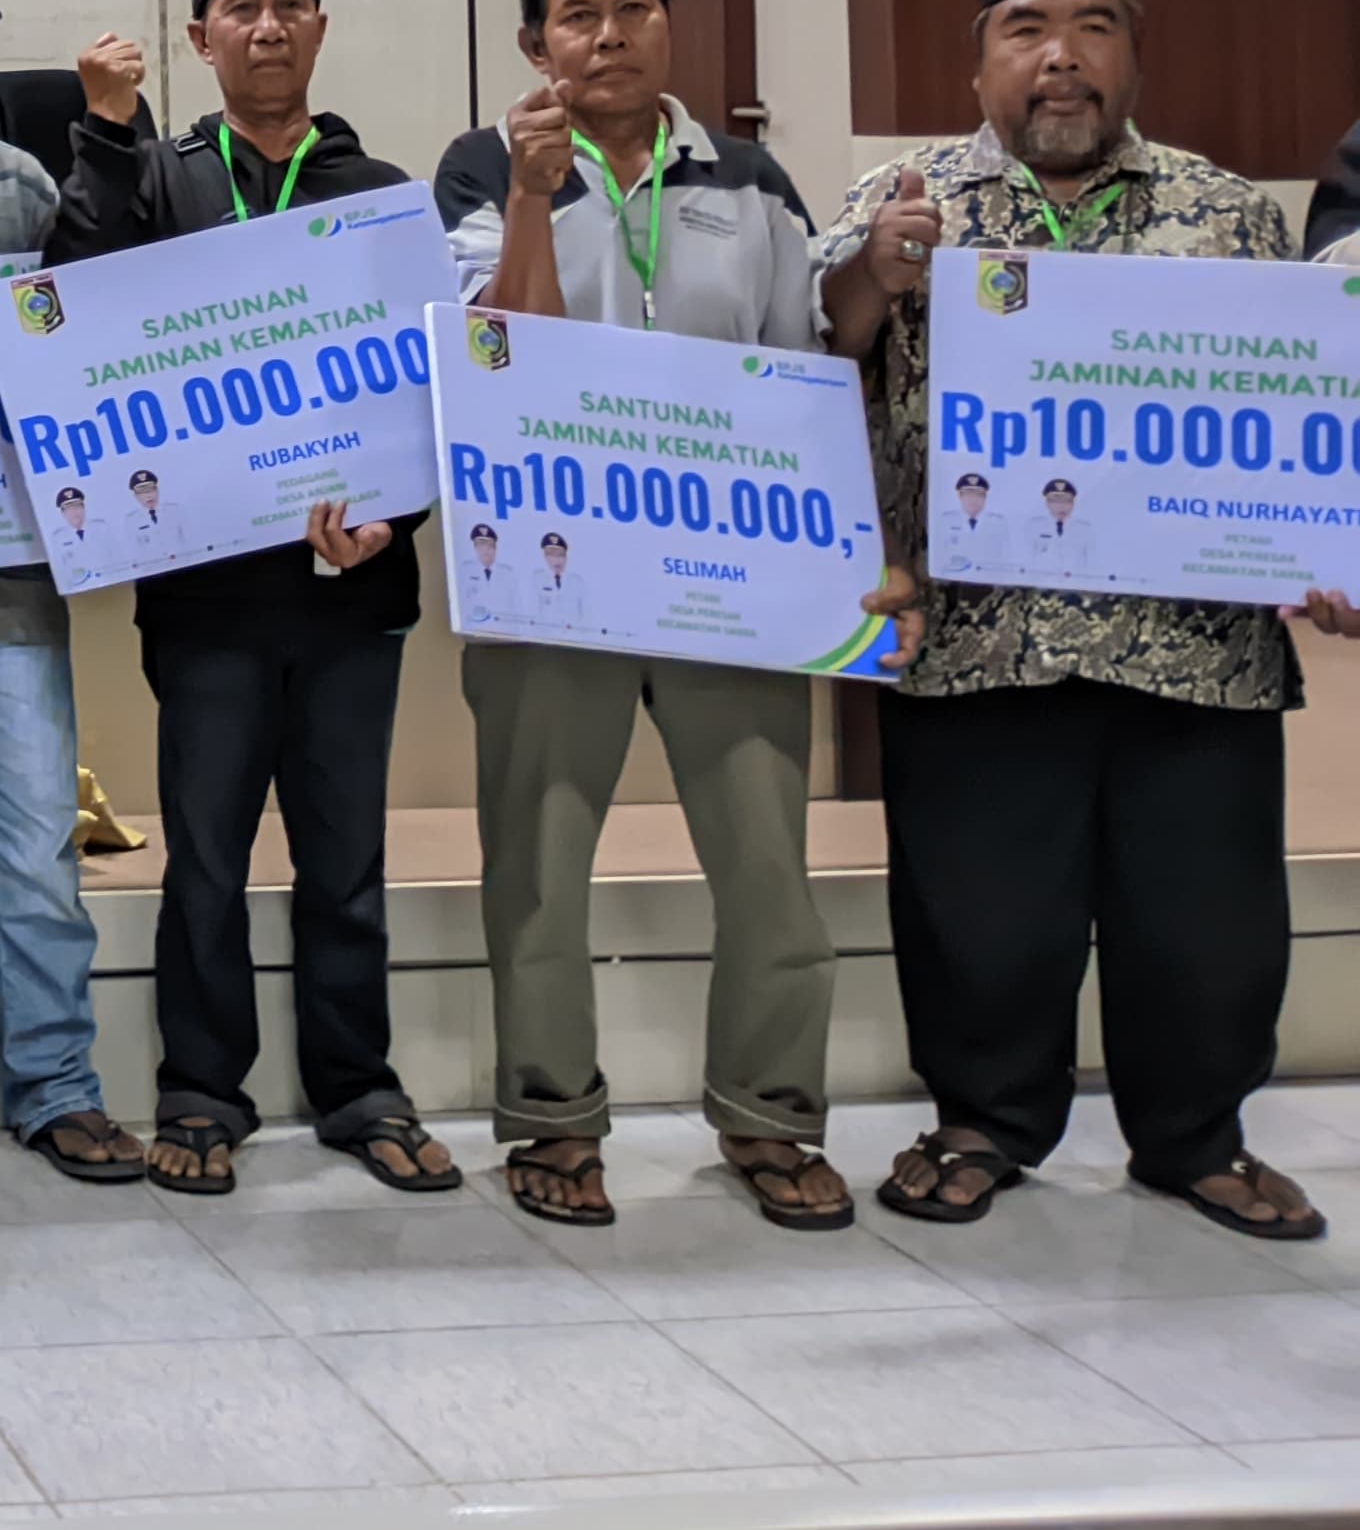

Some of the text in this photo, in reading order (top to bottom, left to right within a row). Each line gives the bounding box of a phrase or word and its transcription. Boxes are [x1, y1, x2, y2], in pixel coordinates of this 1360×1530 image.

[142, 283, 309, 340] SANTUNAN
[82, 299, 388, 388] JAMINAN KEMATIAN
[1111, 329, 1318, 361] SANTUNAN
[1029, 359, 1197, 391] JAMINAN
[18, 327, 430, 478] Rp10.000.000
[580, 391, 733, 431] SANTUNAN
[248, 431, 361, 471] RUBAKYAH
[517, 416, 800, 473] JAMINAN KEMATIAN
[450, 442, 873, 559] Rp10.000.000,-
[1147, 496, 1210, 518] BAIQ
[663, 556, 747, 583] SELIMAH
